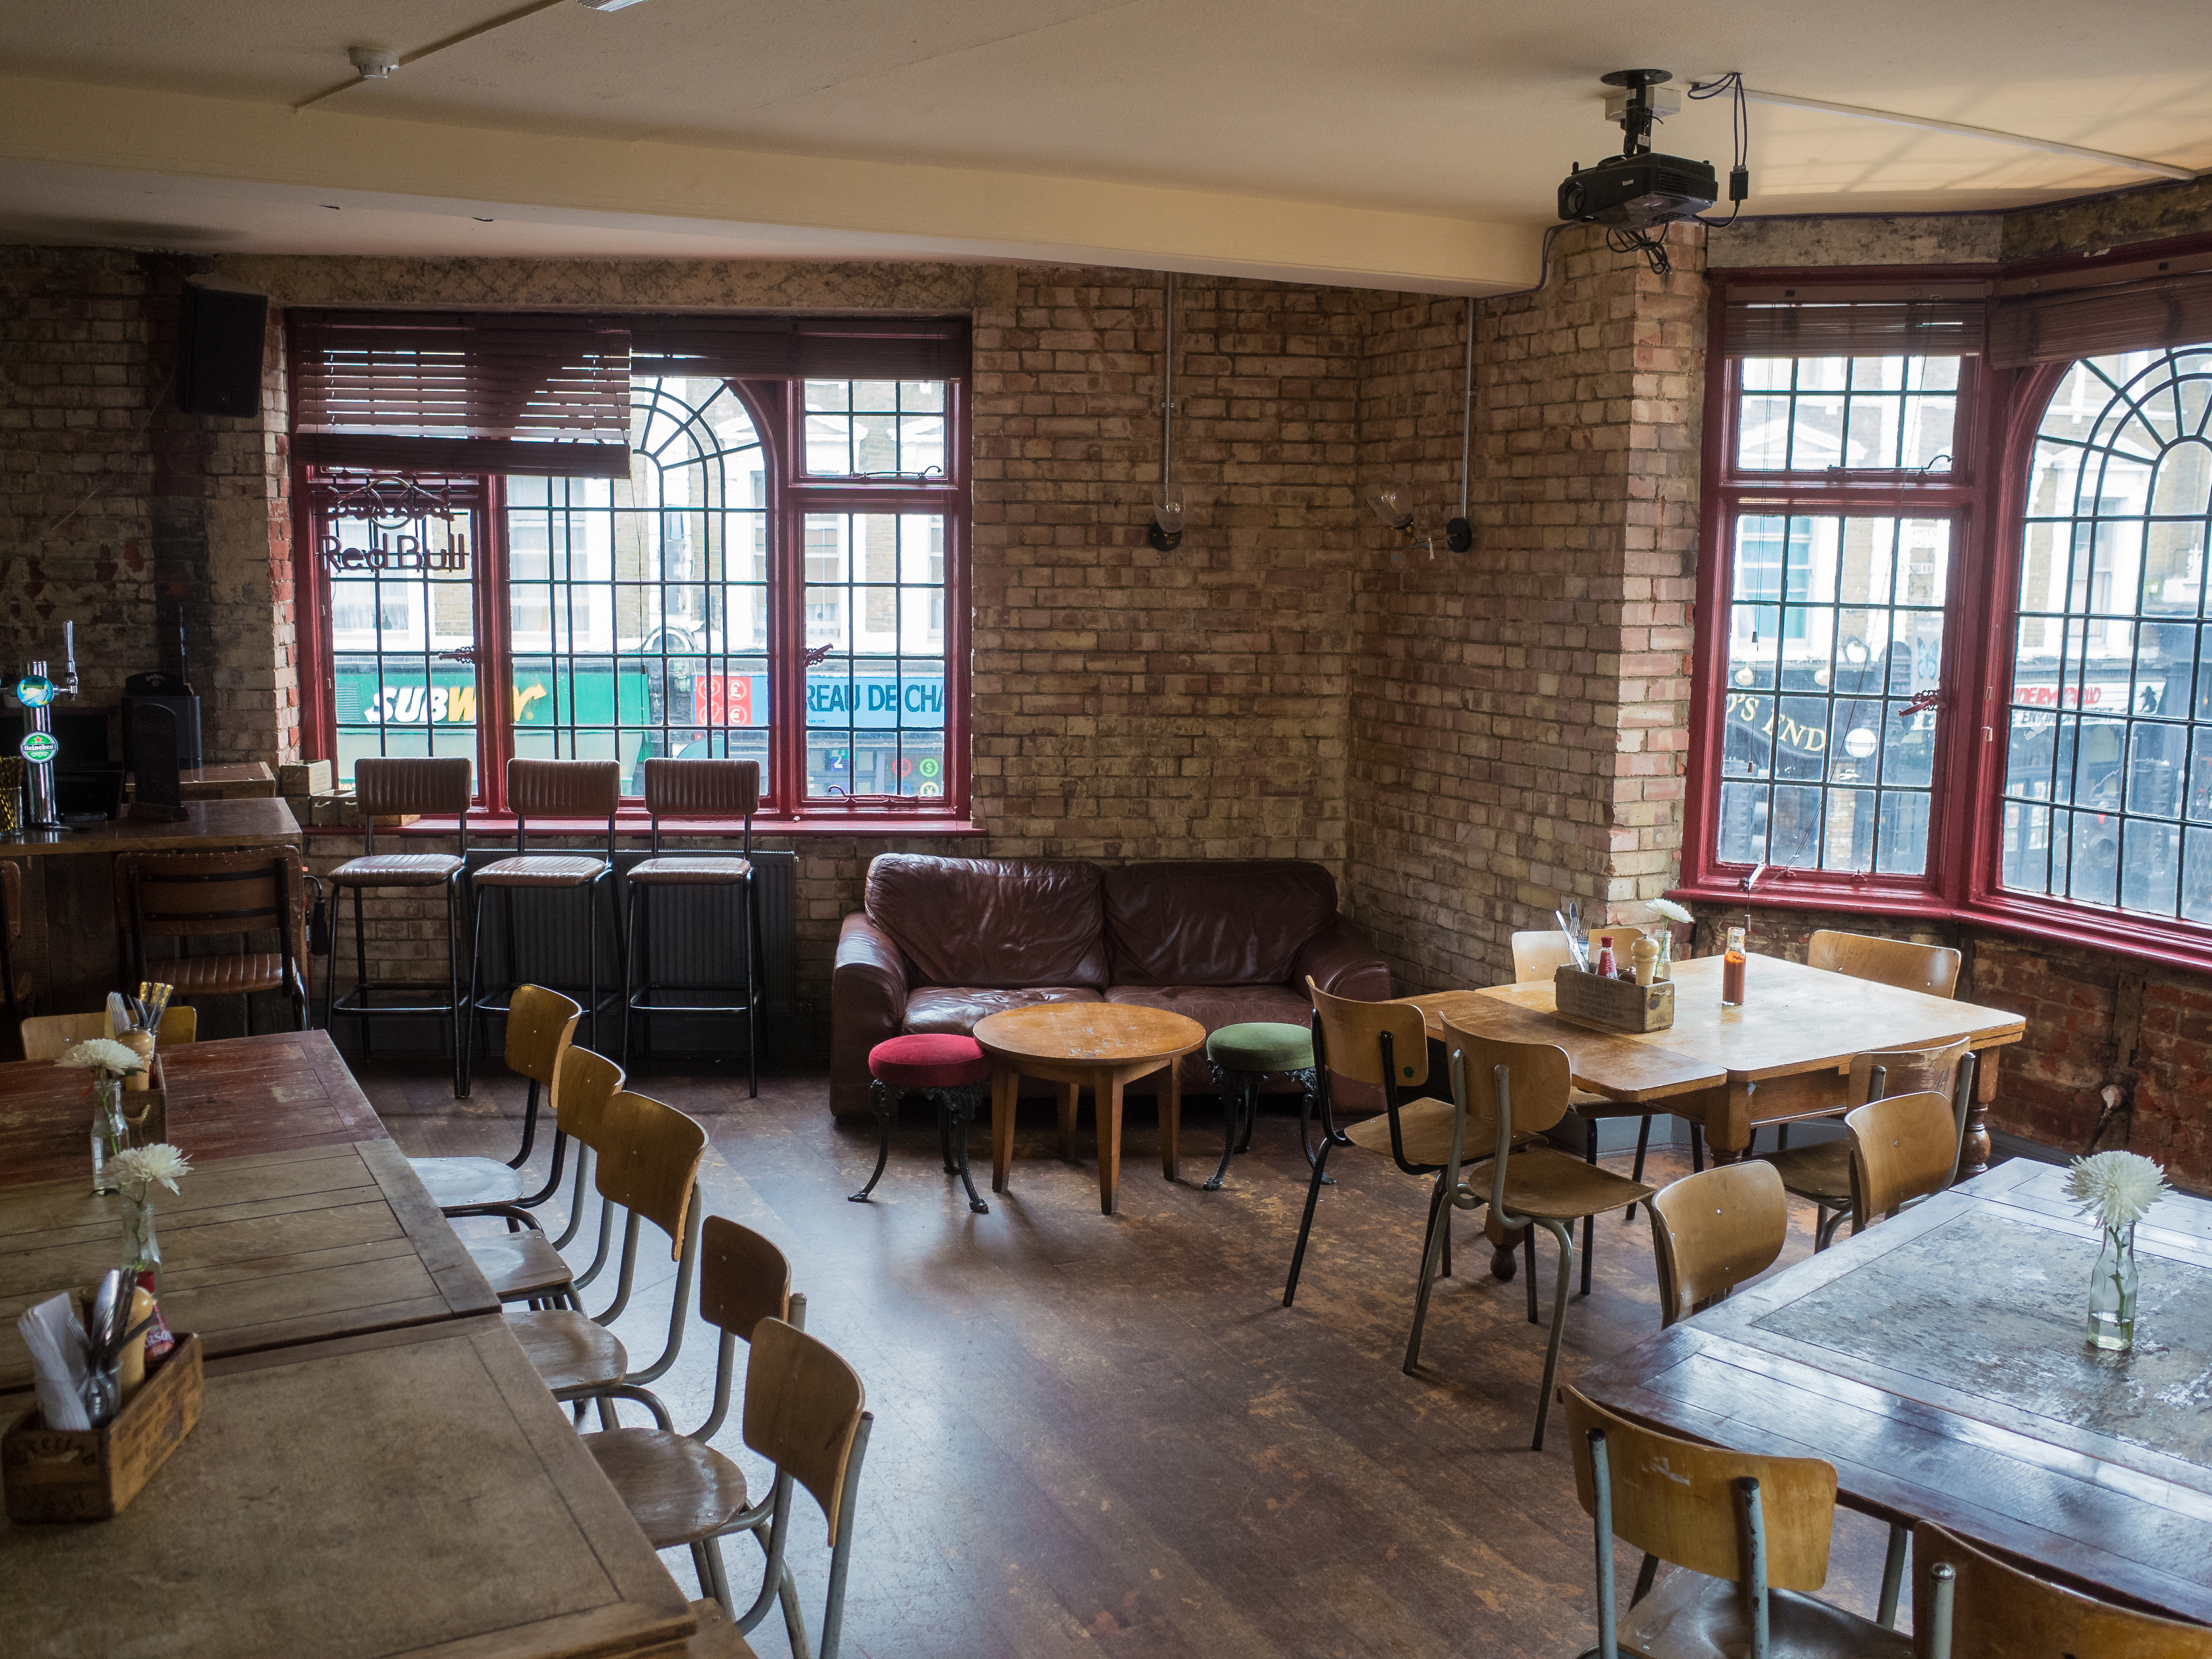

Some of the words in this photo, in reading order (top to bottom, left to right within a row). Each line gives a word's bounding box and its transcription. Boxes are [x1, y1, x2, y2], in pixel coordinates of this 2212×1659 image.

[1912, 539, 1926, 547] OAD
[1913, 529, 1937, 537] AMDEN
[321, 533, 388, 570] Red
[397, 533, 465, 570] Bull
[364, 684, 547, 724] SUBWY
[868, 685, 897, 711] DE
